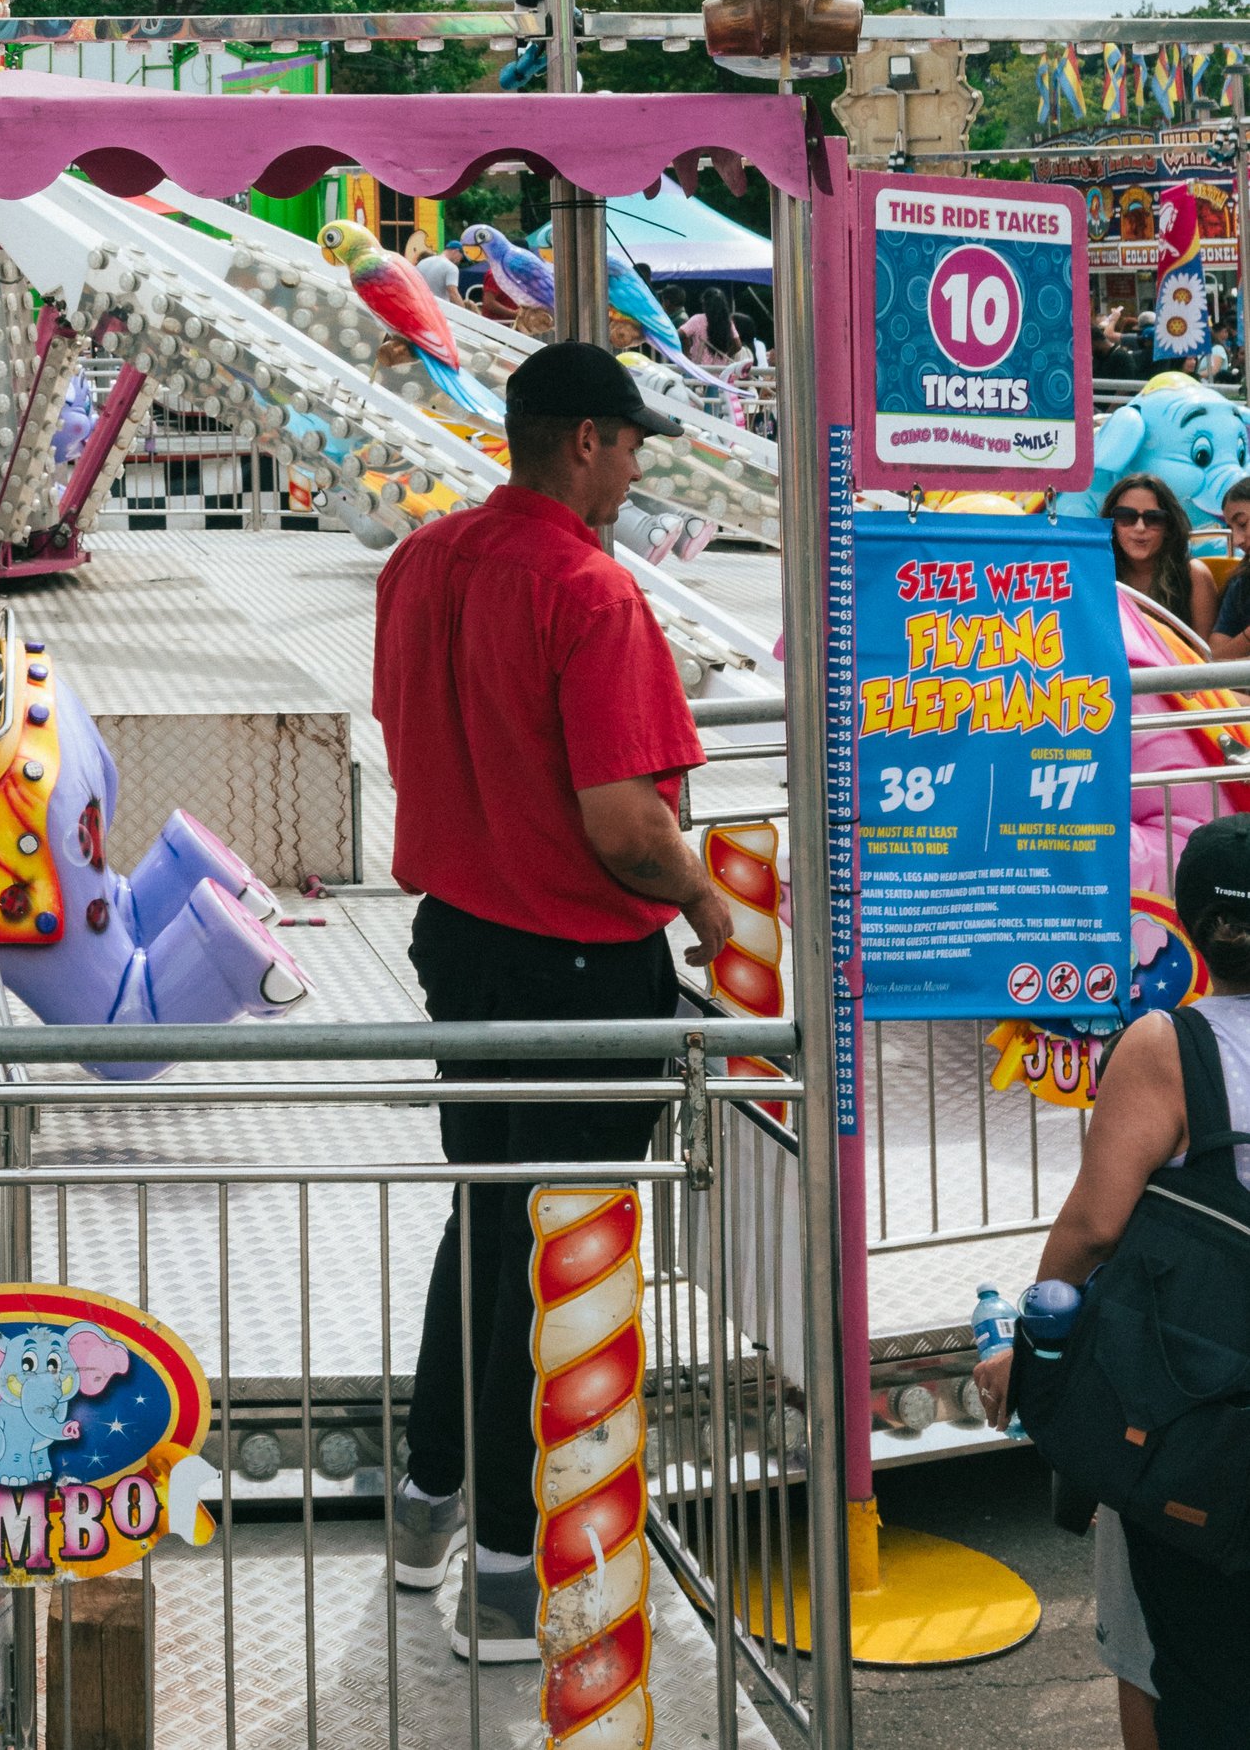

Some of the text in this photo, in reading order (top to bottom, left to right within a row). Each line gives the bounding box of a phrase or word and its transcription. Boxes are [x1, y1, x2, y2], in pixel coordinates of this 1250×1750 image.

[889, 201, 1059, 235] THIS RIDE TAKES
[941, 273, 1010, 346] 10
[922, 374, 1030, 412] TICKETS
[891, 427, 1058, 453] GOING TO MAKE YOU SMILE!
[840, 580, 852, 590] 65
[896, 559, 1073, 604] SIZE WIZE
[840, 610, 852, 620] 63
[840, 625, 852, 635] 62
[905, 606, 1066, 673] FLYING
[840, 656, 851, 665] 60
[839, 671, 851, 680] 59
[839, 701, 851, 710] 57
[859, 670, 1115, 739] ELEPHANTS
[838, 747, 851, 756] 54
[1031, 748, 1092, 760] GUESTS UNDER
[838, 777, 851, 786] 52
[838, 807, 850, 817] 50
[877, 826, 902, 838] MUST
[903, 826, 914, 837] BE
[916, 826, 928, 837] AT
[929, 826, 958, 838] LEAST
[1000, 824, 1115, 835] TALL MUST BE ACCOMPANIED
[837, 838, 850, 848] 48
[868, 842, 949, 854] THIS TALL TO RIDE
[1017, 839, 1096, 851] BY A PAYING ADULT
[837, 853, 850, 863] 47
[860, 871, 872, 881] EEP
[873, 872, 902, 882] HANDS,
[903, 872, 922, 882] LEGS
[923, 872, 938, 882] AND
[940, 871, 957, 881] HEAD
[978, 869, 989, 879] THE
[990, 868, 1004, 878] RIDE
[1006, 868, 1014, 878] AT
[1015, 868, 1028, 878] ALL
[1029, 868, 1051, 877] TIMES.
[861, 888, 883, 898] EMAIN
[885, 889, 913, 899] SEATED
[913, 889, 929, 899] AND
[930, 888, 968, 898] RESTRAINED
[968, 886, 985, 896] UNTIL
[987, 885, 998, 894] THE
[1000, 885, 1016, 894] RIDE
[1017, 885, 1040, 894] COMES
[1042, 885, 1050, 894] TO
[1051, 885, 1056, 894] A
[1057, 885, 1094, 895] COMPLETE
[1215, 886, 1245, 898] Trapeze
[837, 899, 850, 909] 44
[884, 906, 898, 916] ALL
[899, 906, 921, 916] LOOSE
[921, 905, 949, 915] ARTICLES
[950, 903, 974, 914] BEFORE
[861, 918, 1102, 933] UESTS SHOULD EXPECT RAPIDLY CHANGING FORCES. THIS RIDE MAY NOT BE
[837, 930, 850, 940] 42
[861, 937, 890, 947] UITABLE
[892, 937, 905, 947] FOR
[906, 936, 930, 946] GUESTS
[931, 935, 948, 945] WITH
[948, 934, 973, 944] HEALTH
[1016, 932, 1049, 942] PHYSICAL
[1051, 932, 1078, 942] MENTAL
[838, 945, 850, 955] 41
[867, 948, 971, 961] FOR THOSE WHO ARE PREGNANT.
[838, 1007, 851, 1016] 37
[838, 1022, 851, 1032] 36
[839, 1053, 852, 1063] 34
[839, 1069, 852, 1078] 33
[840, 1100, 852, 1109] 31
[840, 1115, 854, 1125] 30
